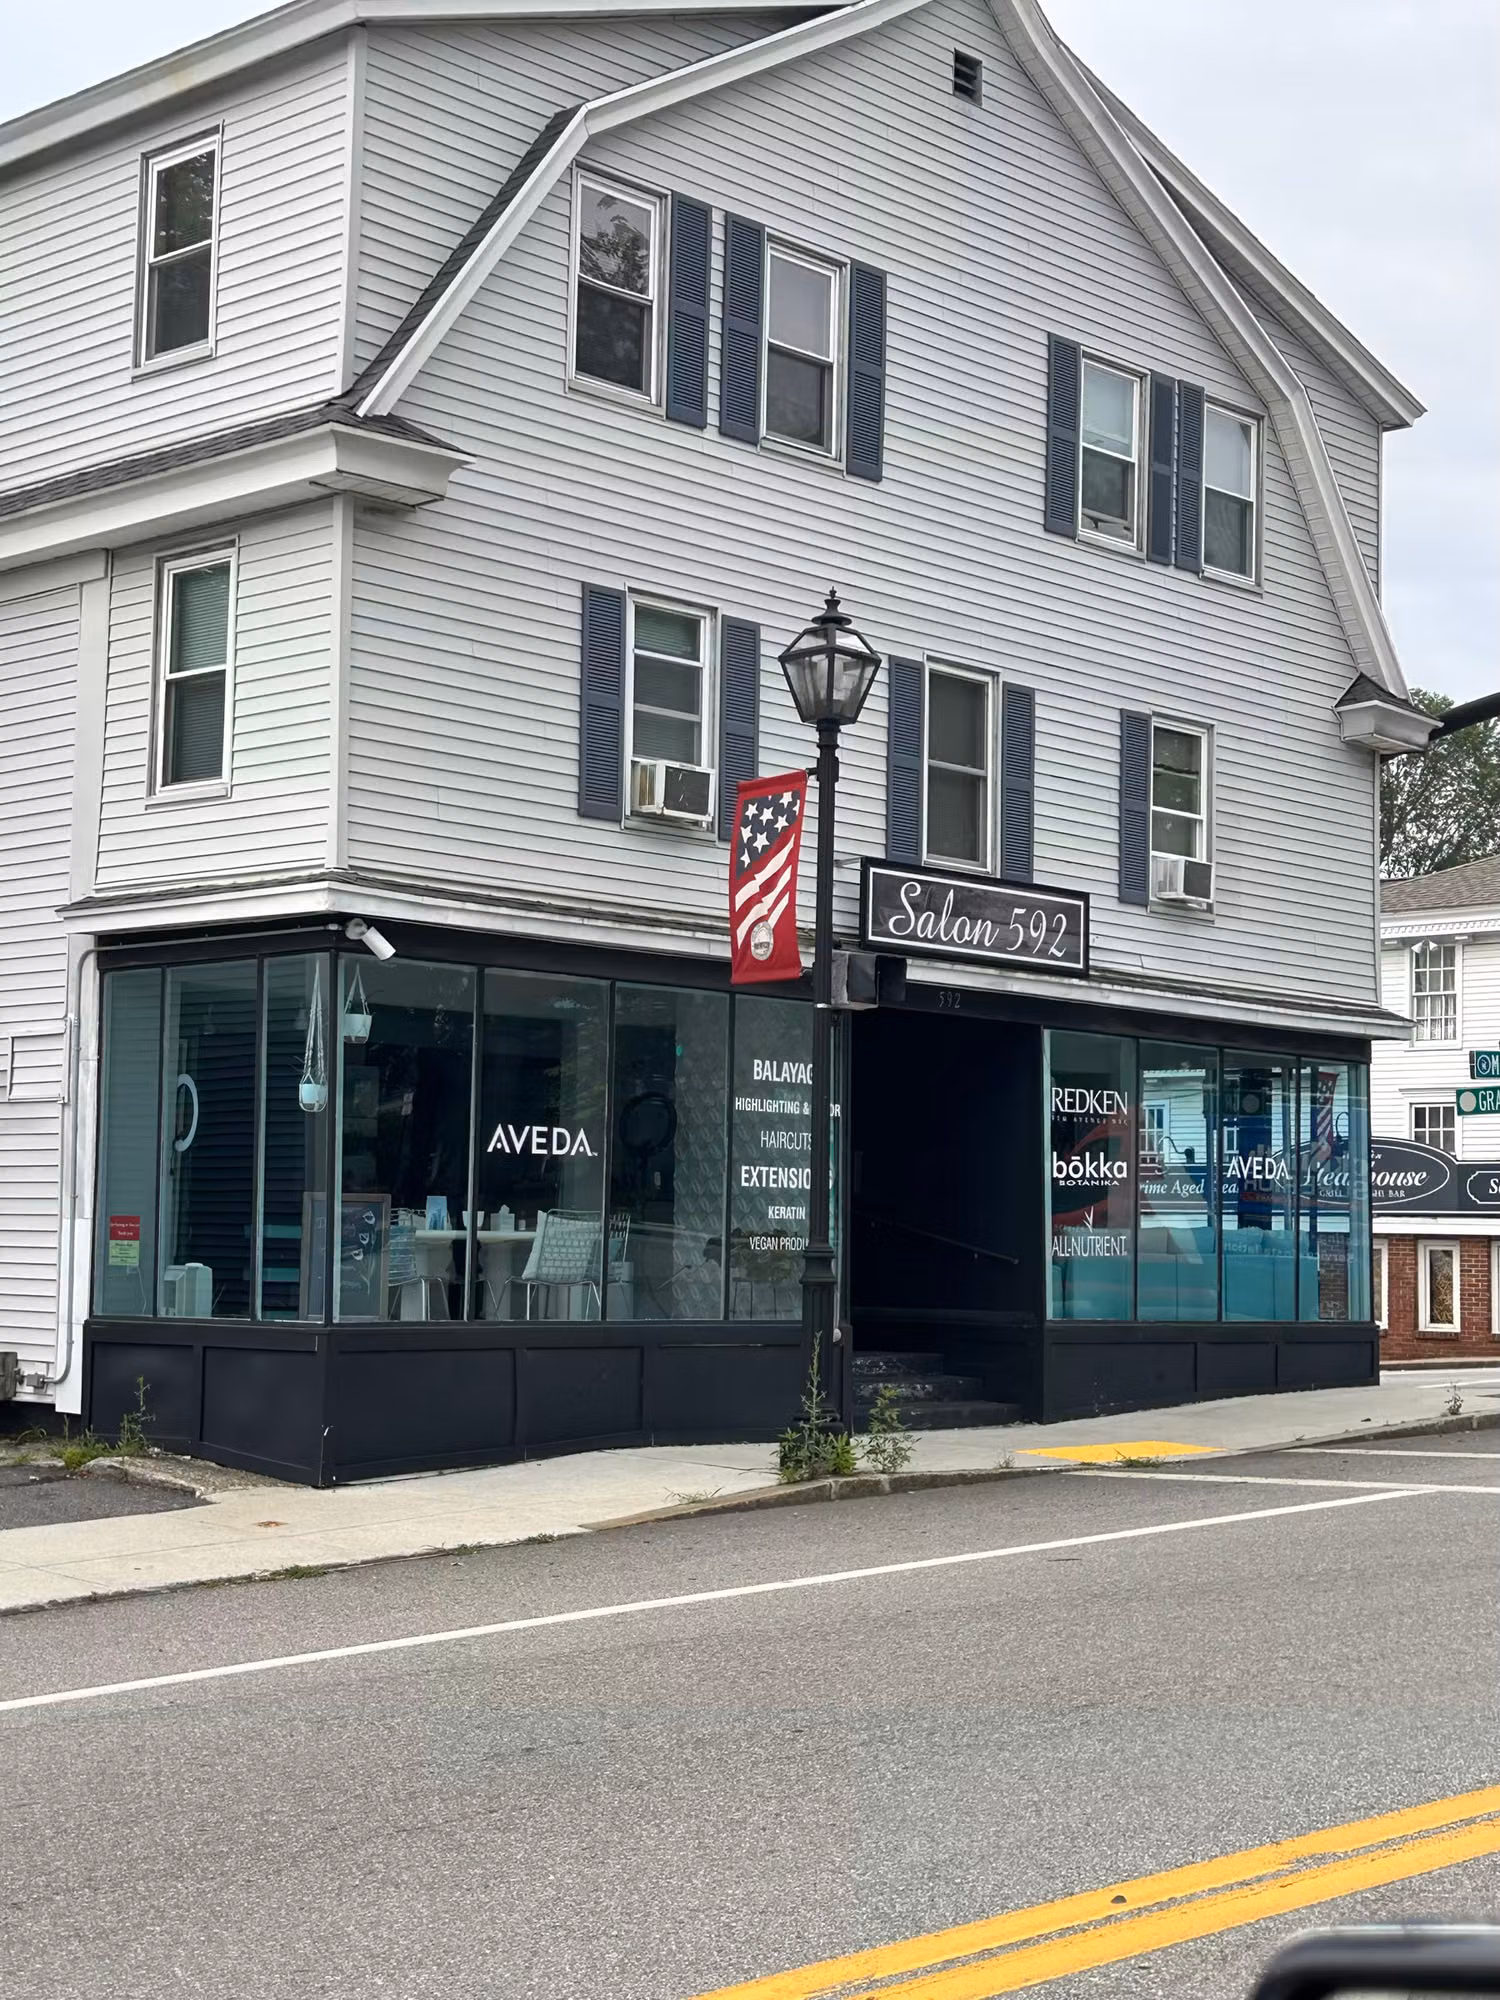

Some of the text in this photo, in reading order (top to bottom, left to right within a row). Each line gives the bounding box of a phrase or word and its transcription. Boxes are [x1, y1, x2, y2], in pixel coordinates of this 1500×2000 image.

[889, 882, 1067, 958] Salon 592
[940, 991, 960, 1008] 592
[753, 1059, 813, 1085] BALAYAG
[735, 1097, 810, 1115] HIGHLIGHTING &
[1051, 1087, 1128, 1115] REDKEN
[486, 1123, 594, 1157] AVEDA
[741, 1165, 833, 1190] EXTENSIO
[1226, 1155, 1290, 1181] AVEDA
[1139, 1180, 1167, 1194] rime
[1170, 1179, 1205, 1198] Aged
[1388, 1189, 1406, 1198] BAR
[768, 1205, 806, 1220] KERATIN
[749, 1236, 809, 1250] VEGAN PRODU
